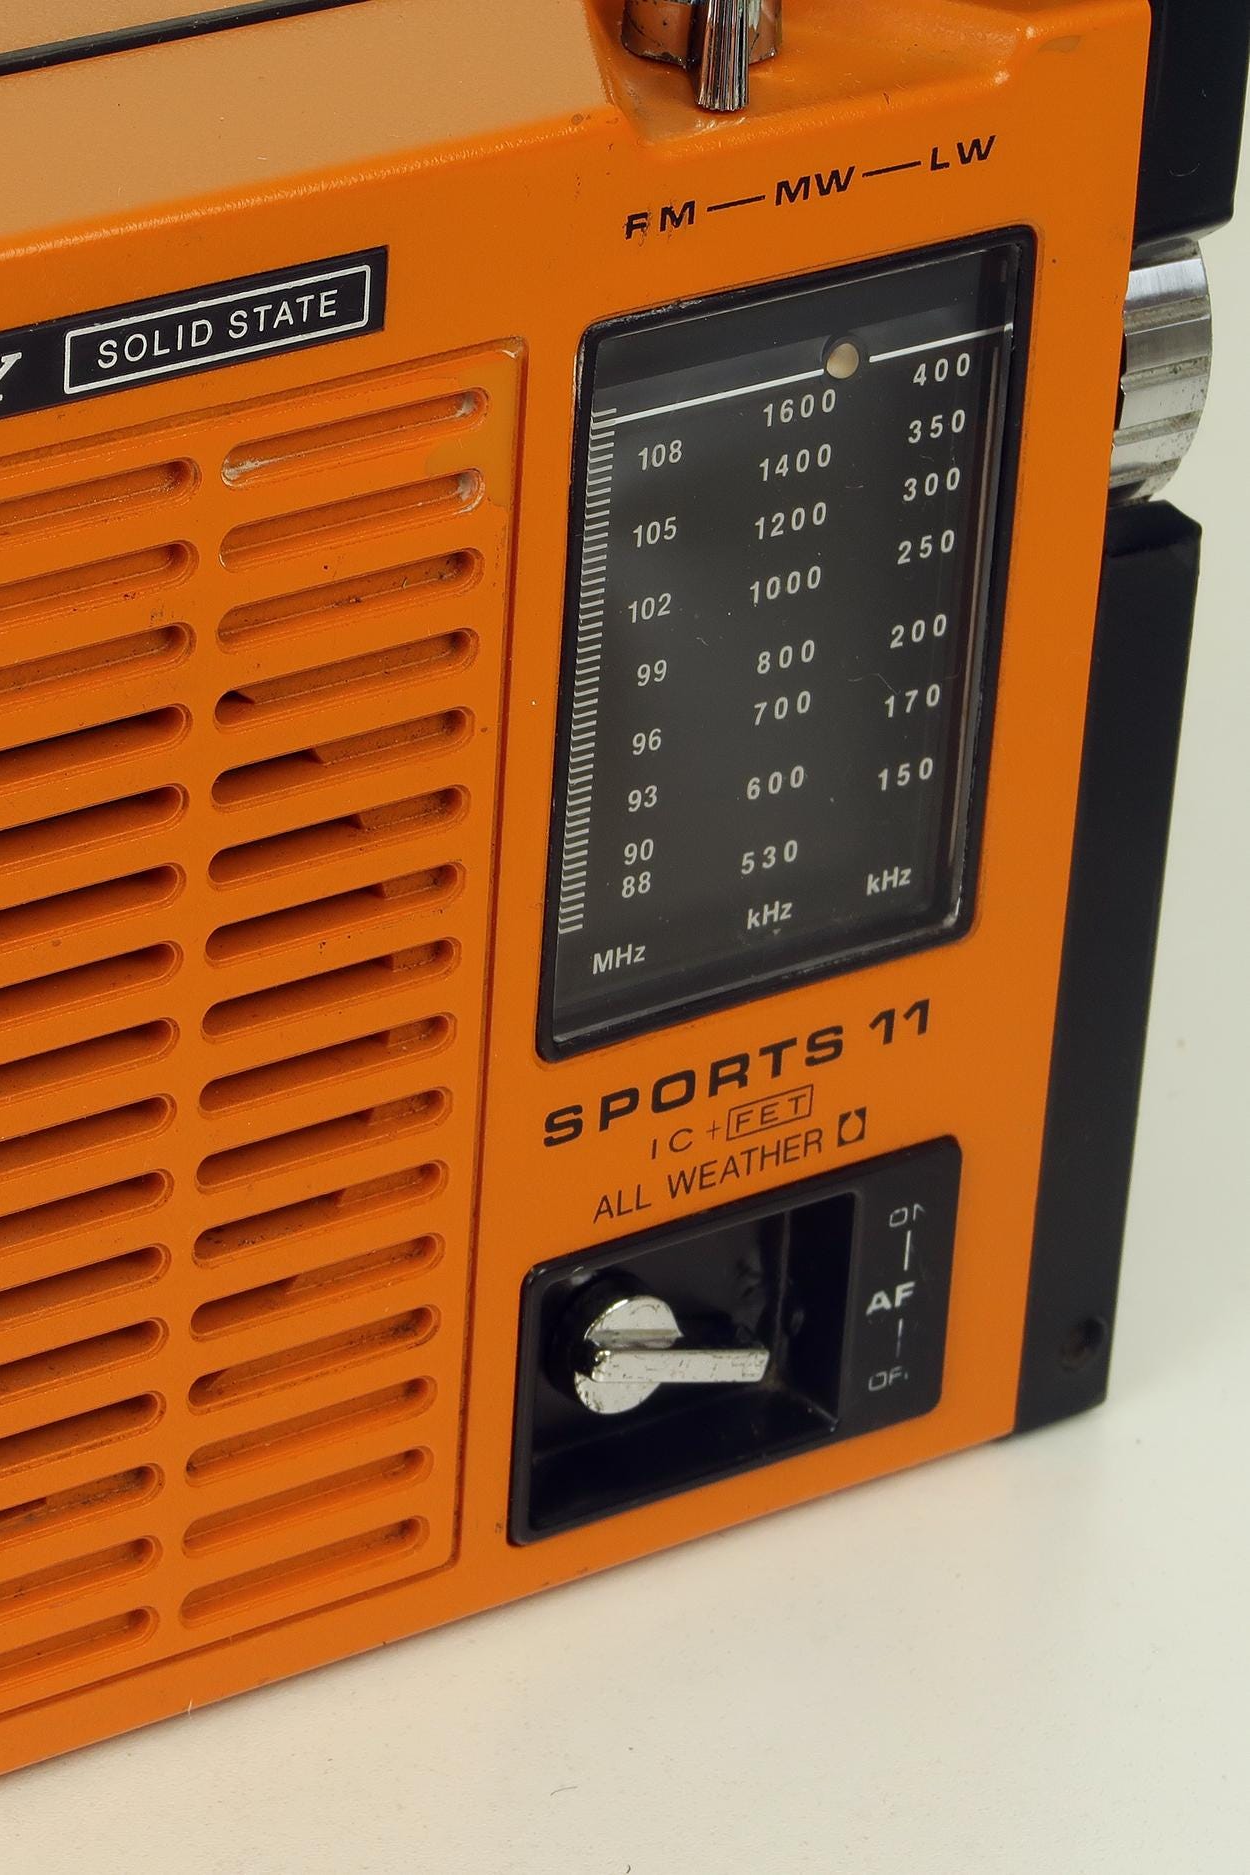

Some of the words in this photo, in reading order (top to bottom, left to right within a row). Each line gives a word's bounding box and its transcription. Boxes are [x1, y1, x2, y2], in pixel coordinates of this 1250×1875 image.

[929, 134, 997, 172] LW
[775, 165, 856, 207] MW
[624, 199, 696, 240] FM
[97, 320, 213, 370] SOLID
[227, 289, 338, 340] STATE
[912, 352, 972, 387] 400
[762, 387, 837, 428] 1600
[907, 408, 967, 445] 350
[637, 438, 684, 472] 108
[758, 442, 833, 483] 1400
[902, 466, 961, 502] 300
[632, 515, 678, 549] 105
[754, 501, 828, 541] 1200
[896, 528, 956, 566] 250
[749, 565, 822, 605] 1000
[627, 592, 672, 625] 102
[889, 613, 948, 649] 200
[636, 658, 668, 687] 99
[756, 638, 816, 675] 800
[753, 690, 812, 727] 700
[883, 682, 941, 719] 170
[631, 727, 663, 756] 96
[746, 764, 806, 801] 600
[877, 756, 934, 792] 150
[627, 784, 659, 813] 93
[623, 837, 655, 866] 90
[740, 839, 799, 875] 530
[621, 870, 652, 899] 88
[865, 865, 912, 897] kHz
[746, 900, 794, 931] kHz
[591, 941, 647, 975] MHz
[542, 1024, 845, 1148] SPORTS
[868, 997, 932, 1047] 11
[733, 1092, 808, 1134] FET
[591, 1182, 652, 1224] ALL
[666, 1126, 825, 1201] WEATHER
[865, 1280, 916, 1316] AF
[867, 1364, 910, 1392] OF
